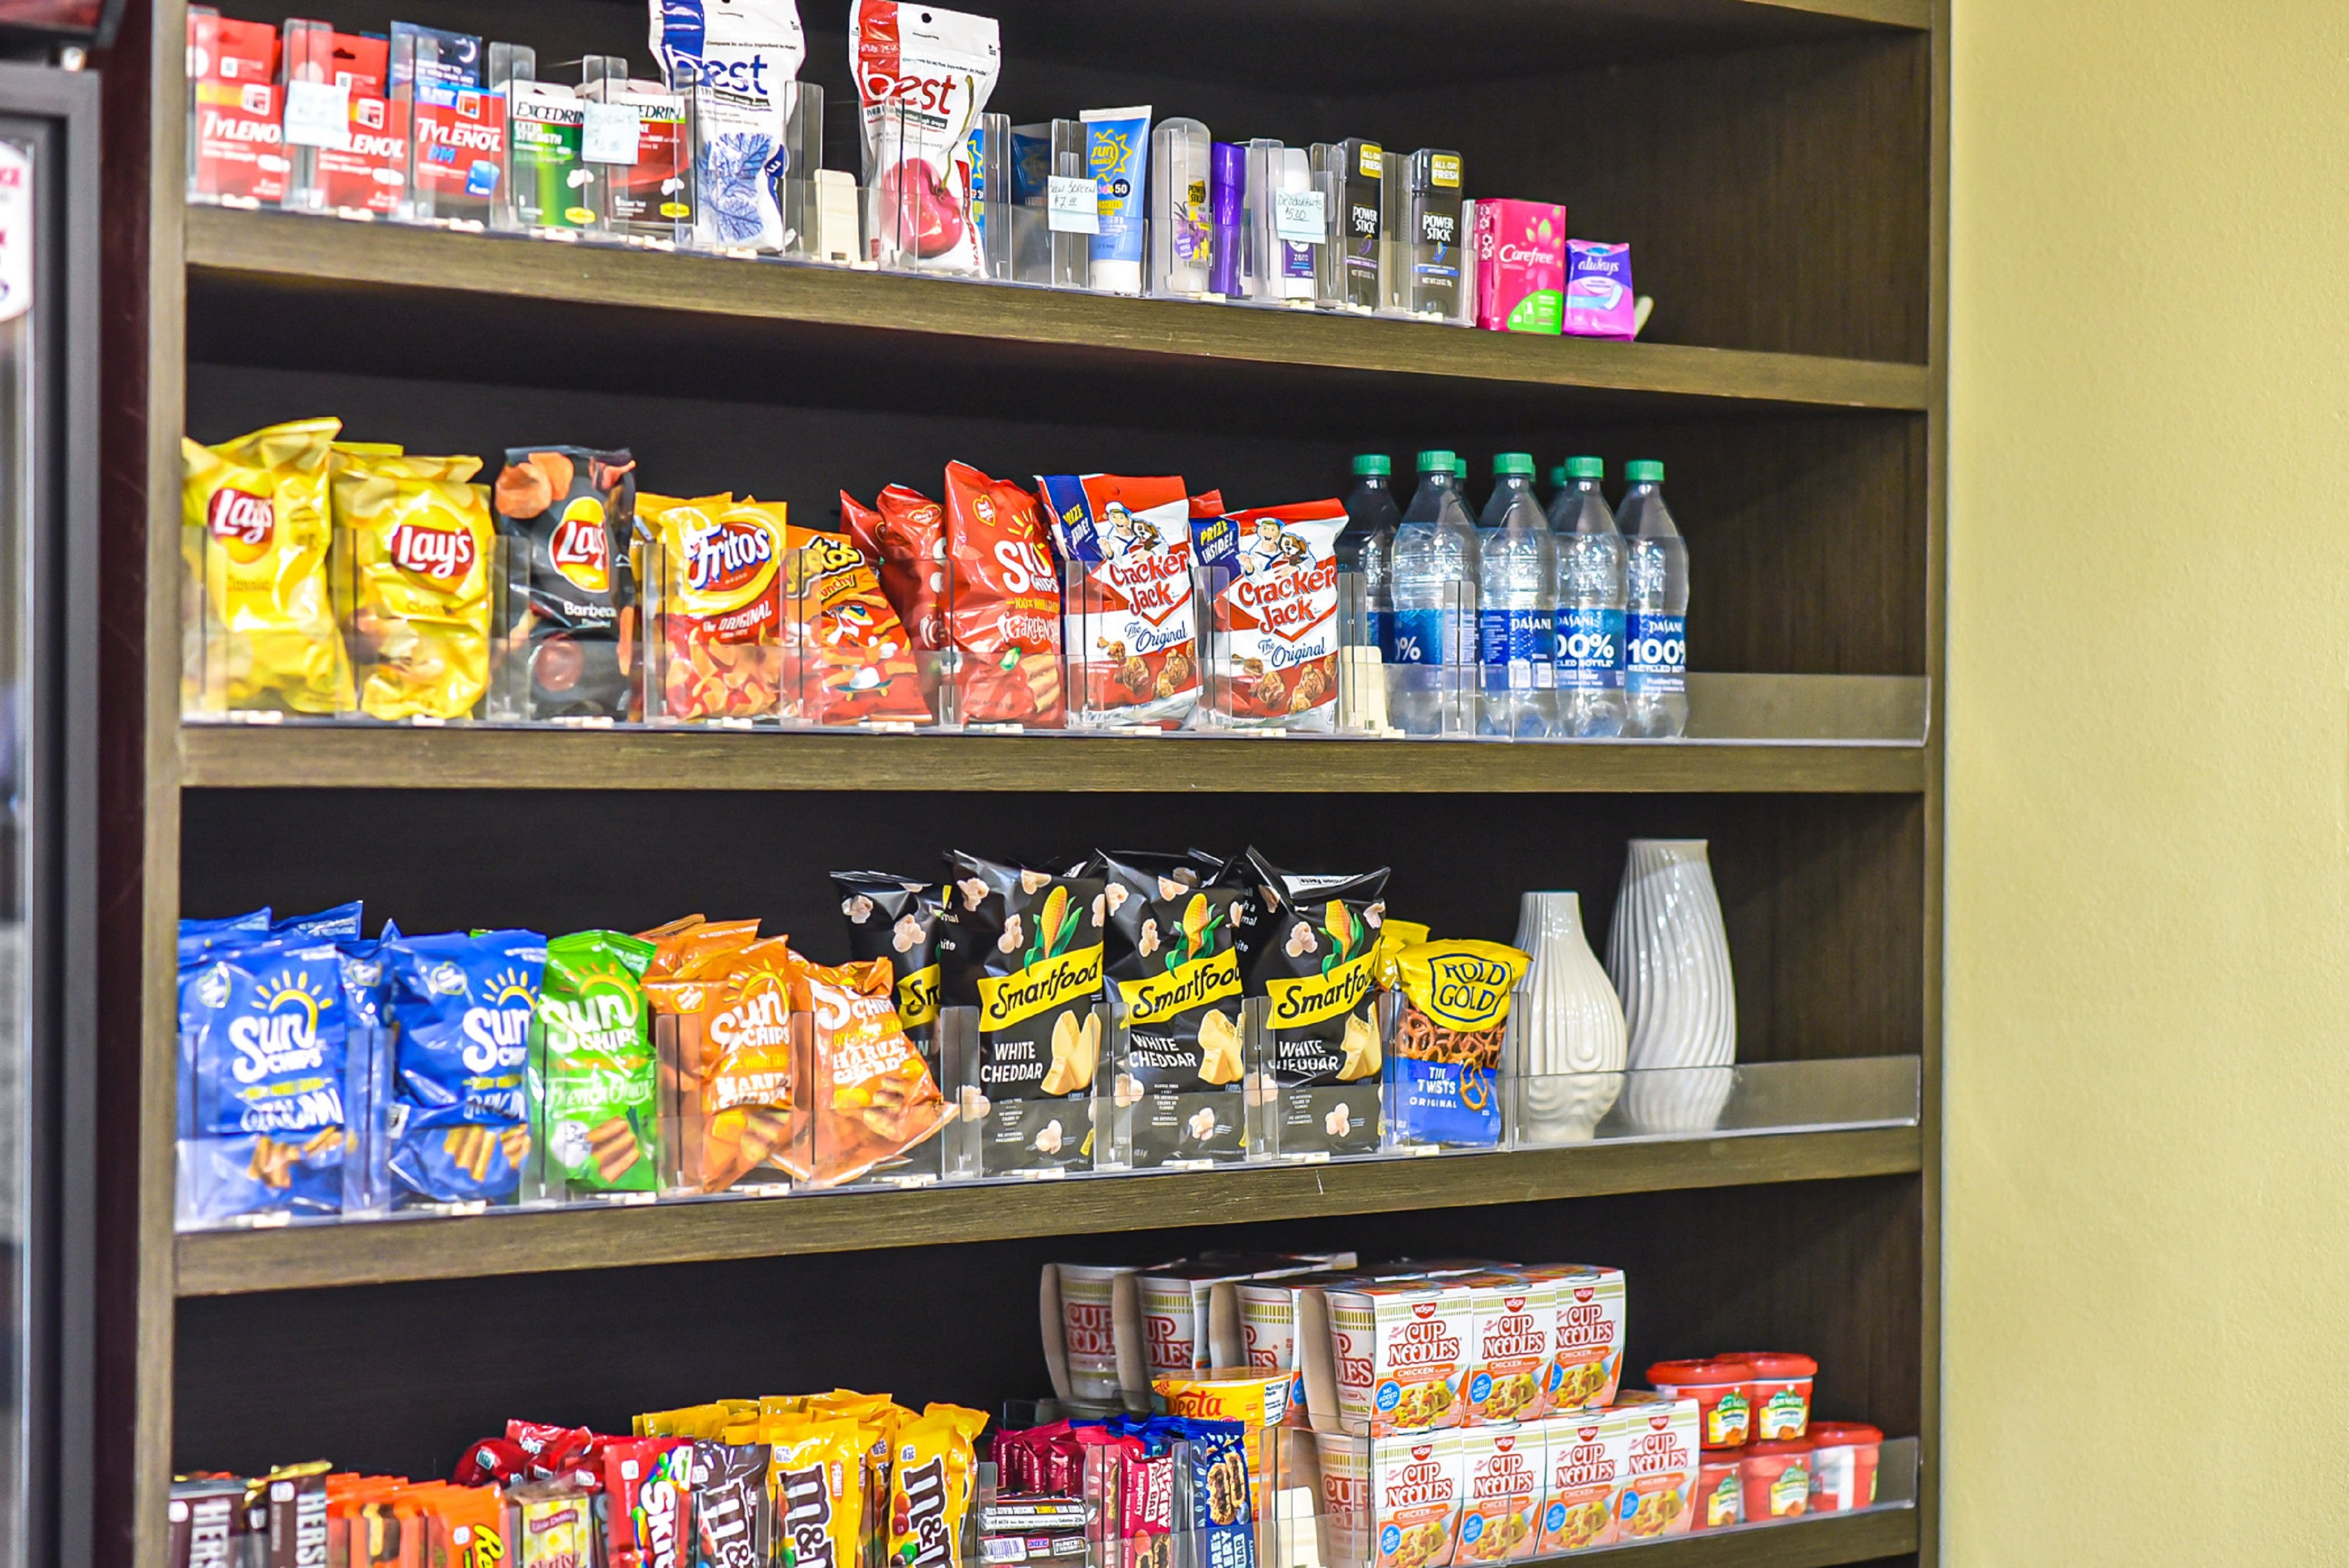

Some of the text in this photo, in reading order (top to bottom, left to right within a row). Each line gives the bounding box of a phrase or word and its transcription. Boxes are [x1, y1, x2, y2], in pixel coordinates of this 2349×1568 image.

[862, 61, 956, 114] best
[202, 110, 283, 143] TYLENO
[418, 117, 502, 152] TYLENOL
[1433, 170, 1458, 180] FRESH
[1115, 184, 1127, 193] 50
[1353, 206, 1378, 222] POWER
[1423, 215, 1453, 230] POWER
[1356, 221, 1375, 234] STICK
[1427, 228, 1452, 242] STICK
[1500, 243, 1554, 267] Carefree
[1578, 256, 1620, 276] always
[1200, 520, 1228, 546] PRIZE
[399, 526, 472, 579] Lay's
[684, 522, 771, 590] Fritos
[1201, 530, 1234, 564] INSIDE!
[1110, 551, 1189, 587] Cracker
[820, 573, 855, 598] unchy
[1238, 566, 1334, 607] Cracker
[1130, 582, 1173, 615] Jack
[718, 600, 773, 631] ORIGINAL
[1260, 595, 1316, 634] Jack
[1511, 616, 1551, 633] DASANI
[1124, 621, 1188, 655] The Original
[1258, 636, 1326, 667] The Original
[990, 952, 1102, 1019] Smartfood
[1443, 962, 1507, 986] ROLD
[1439, 984, 1496, 1011] GOLD
[538, 994, 639, 1054] Sun
[710, 991, 789, 1055] Sun
[228, 1013, 317, 1083] Sun
[462, 1006, 530, 1072] Sun
[741, 1026, 790, 1047] CHIPS
[1131, 1033, 1180, 1052] WHITE
[1279, 1040, 1326, 1058] WHITE
[994, 1041, 1036, 1061] WHITE
[1129, 1051, 1197, 1068] CHEDDAR
[981, 1063, 1043, 1083] CHEDDAR
[1409, 1096, 1458, 1109] ORIGINAL
[1499, 1314, 1534, 1336] CUP
[1567, 1304, 1603, 1326] CUP
[1406, 1320, 1446, 1344] CUP
[1556, 1320, 1614, 1348] NOODLES
[1388, 1337, 1460, 1367] NOODLES
[1482, 1331, 1545, 1359] NOODLES
[1398, 1367, 1434, 1377] CHICKEN
[1491, 1361, 1522, 1370] CHICKEN
[1378, 1391, 1398, 1403] ADDED
[1381, 1398, 1394, 1408] MSG
[1570, 1443, 1605, 1465] CUP
[1642, 1432, 1677, 1454] CUP
[1403, 1462, 1441, 1485] CUP
[1488, 1454, 1523, 1476] CUP
[1556, 1458, 1616, 1488] NOODLES
[1628, 1448, 1688, 1476] NOODLES
[831, 1463, 843, 1498] PEANUT
[1386, 1478, 1453, 1507] NOODLES
[1473, 1470, 1534, 1499] NOODLES
[1134, 1471, 1146, 1516] Raspberry
[1147, 1491, 1158, 1518] BAR
[1397, 1508, 1430, 1520] CHICKEN
